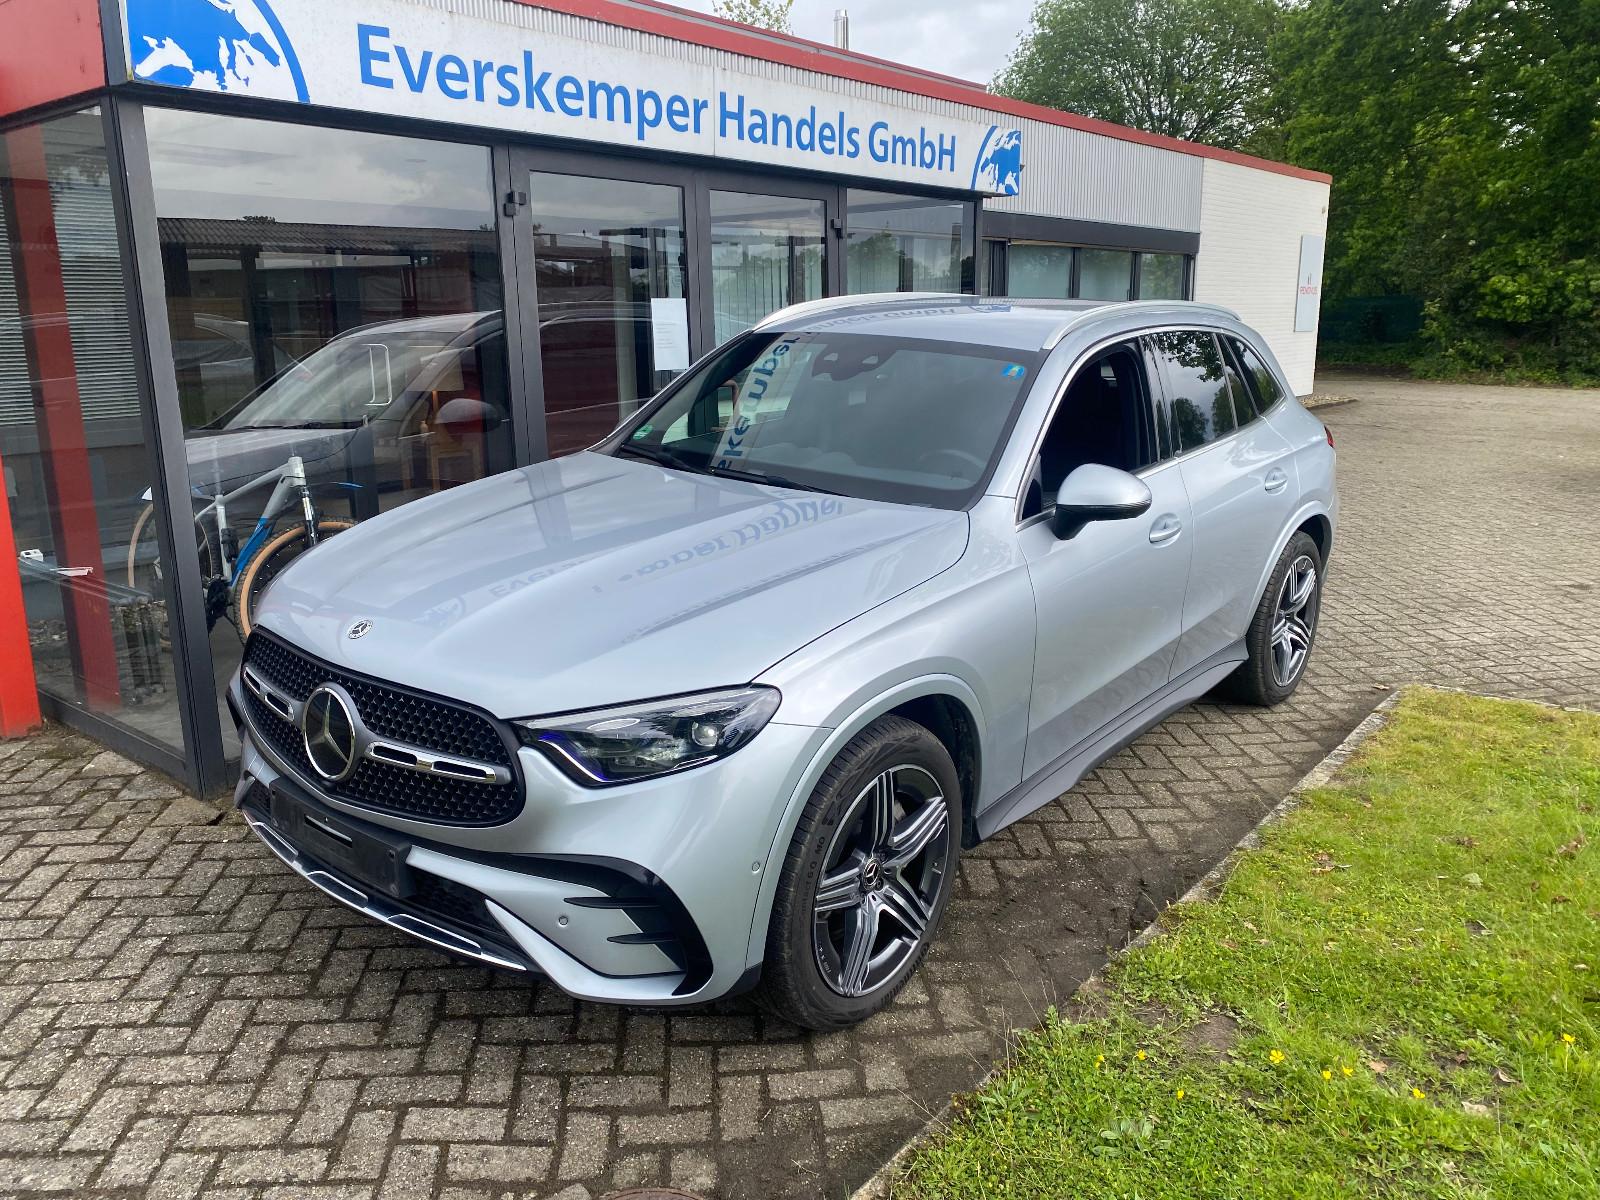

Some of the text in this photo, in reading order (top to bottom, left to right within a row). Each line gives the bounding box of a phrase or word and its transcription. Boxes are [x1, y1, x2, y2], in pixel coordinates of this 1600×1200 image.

[357, 23, 956, 172] Everskemper Handels GmbH
